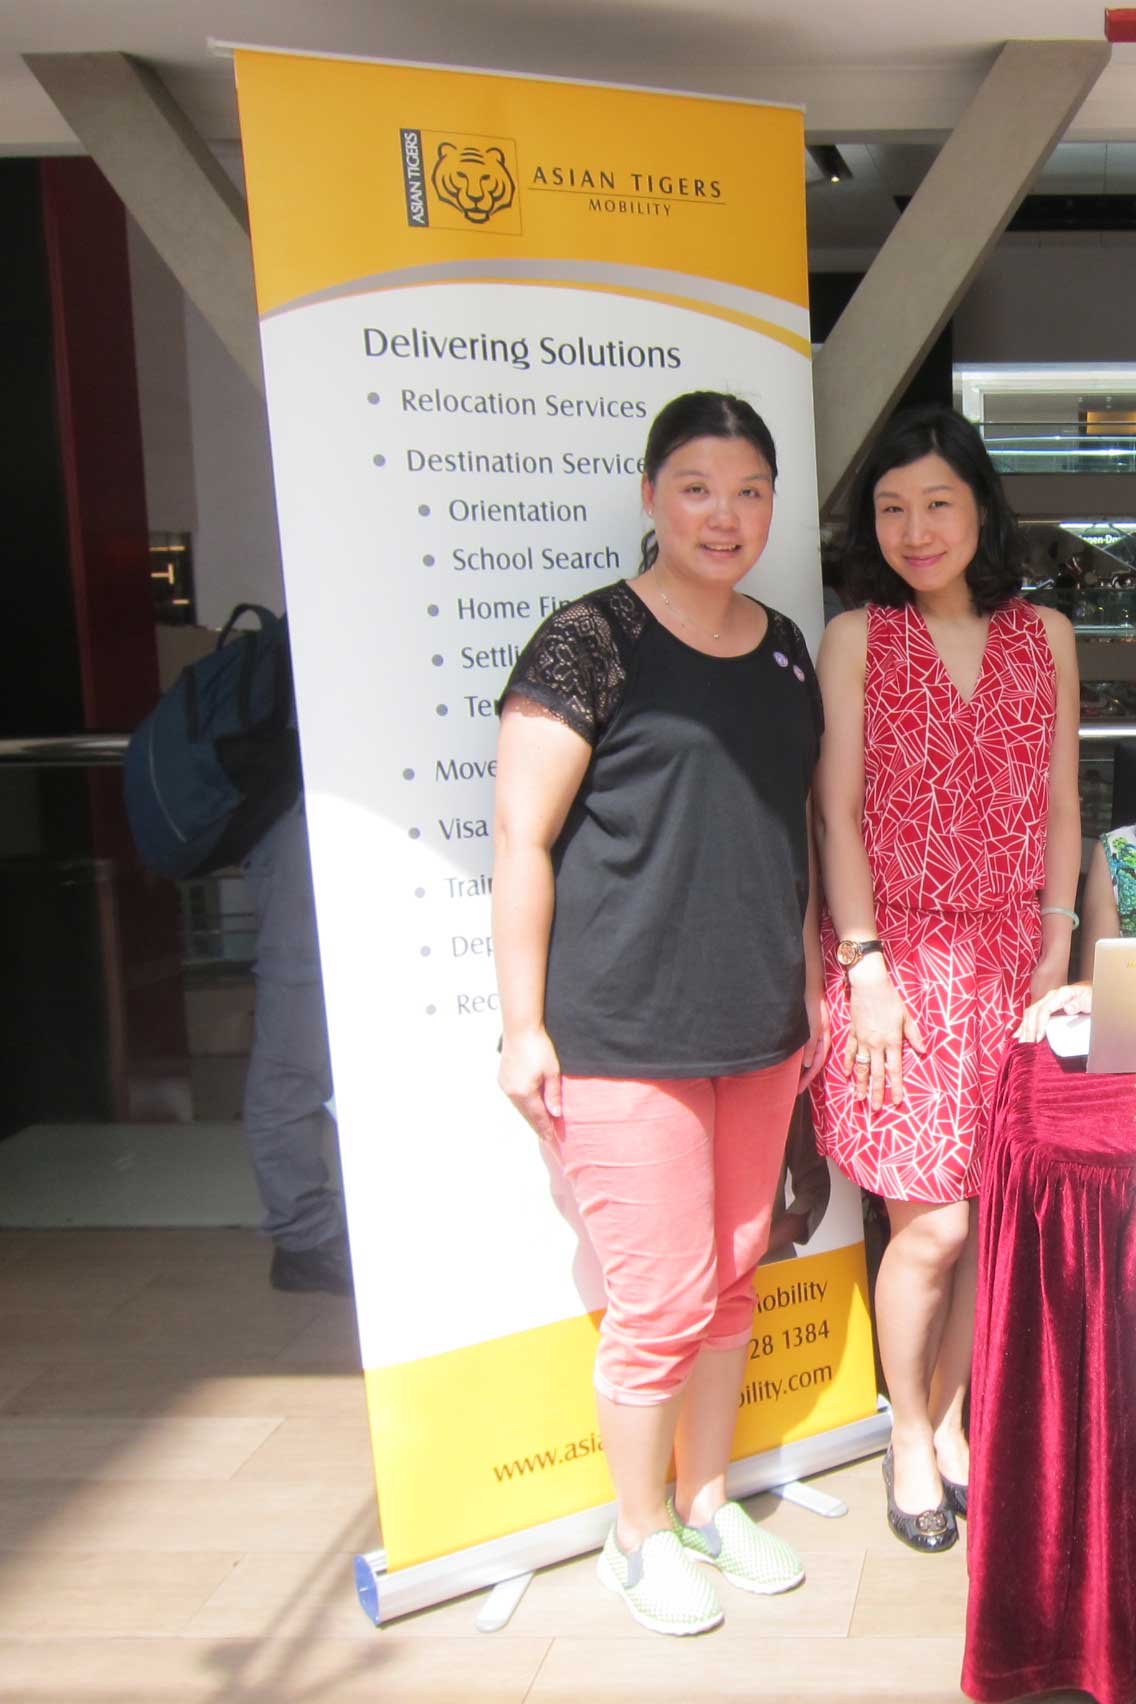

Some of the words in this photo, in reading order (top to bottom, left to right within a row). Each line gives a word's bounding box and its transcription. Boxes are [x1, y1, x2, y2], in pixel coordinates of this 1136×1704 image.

[404, 132, 423, 178] TIGERS
[533, 166, 615, 190] ASIAN
[631, 173, 722, 198] TIGERS
[411, 181, 425, 224] ASIAN
[588, 199, 672, 217] MOBILITY
[364, 328, 530, 370] Delivering
[541, 336, 681, 369] Solutions
[401, 388, 536, 416] Relocation
[547, 393, 647, 418] Services
[407, 449, 553, 474] Destination
[563, 453, 646, 475] Service
[449, 499, 587, 522] Orientation
[452, 547, 533, 571] School
[542, 546, 620, 570] Search
[457, 597, 530, 620] Home
[540, 595, 569, 617] Fi
[461, 644, 520, 669] Settli
[464, 695, 500, 718] Te
[438, 818, 489, 841] Visa
[443, 874, 493, 898] Trai
[457, 993, 499, 1015] Rec
[756, 1280, 829, 1314] obility
[750, 1334, 774, 1360] 28
[782, 1319, 830, 1349] 1384
[493, 1432, 605, 1482] www.asi
[738, 1365, 833, 1408] ility.com
